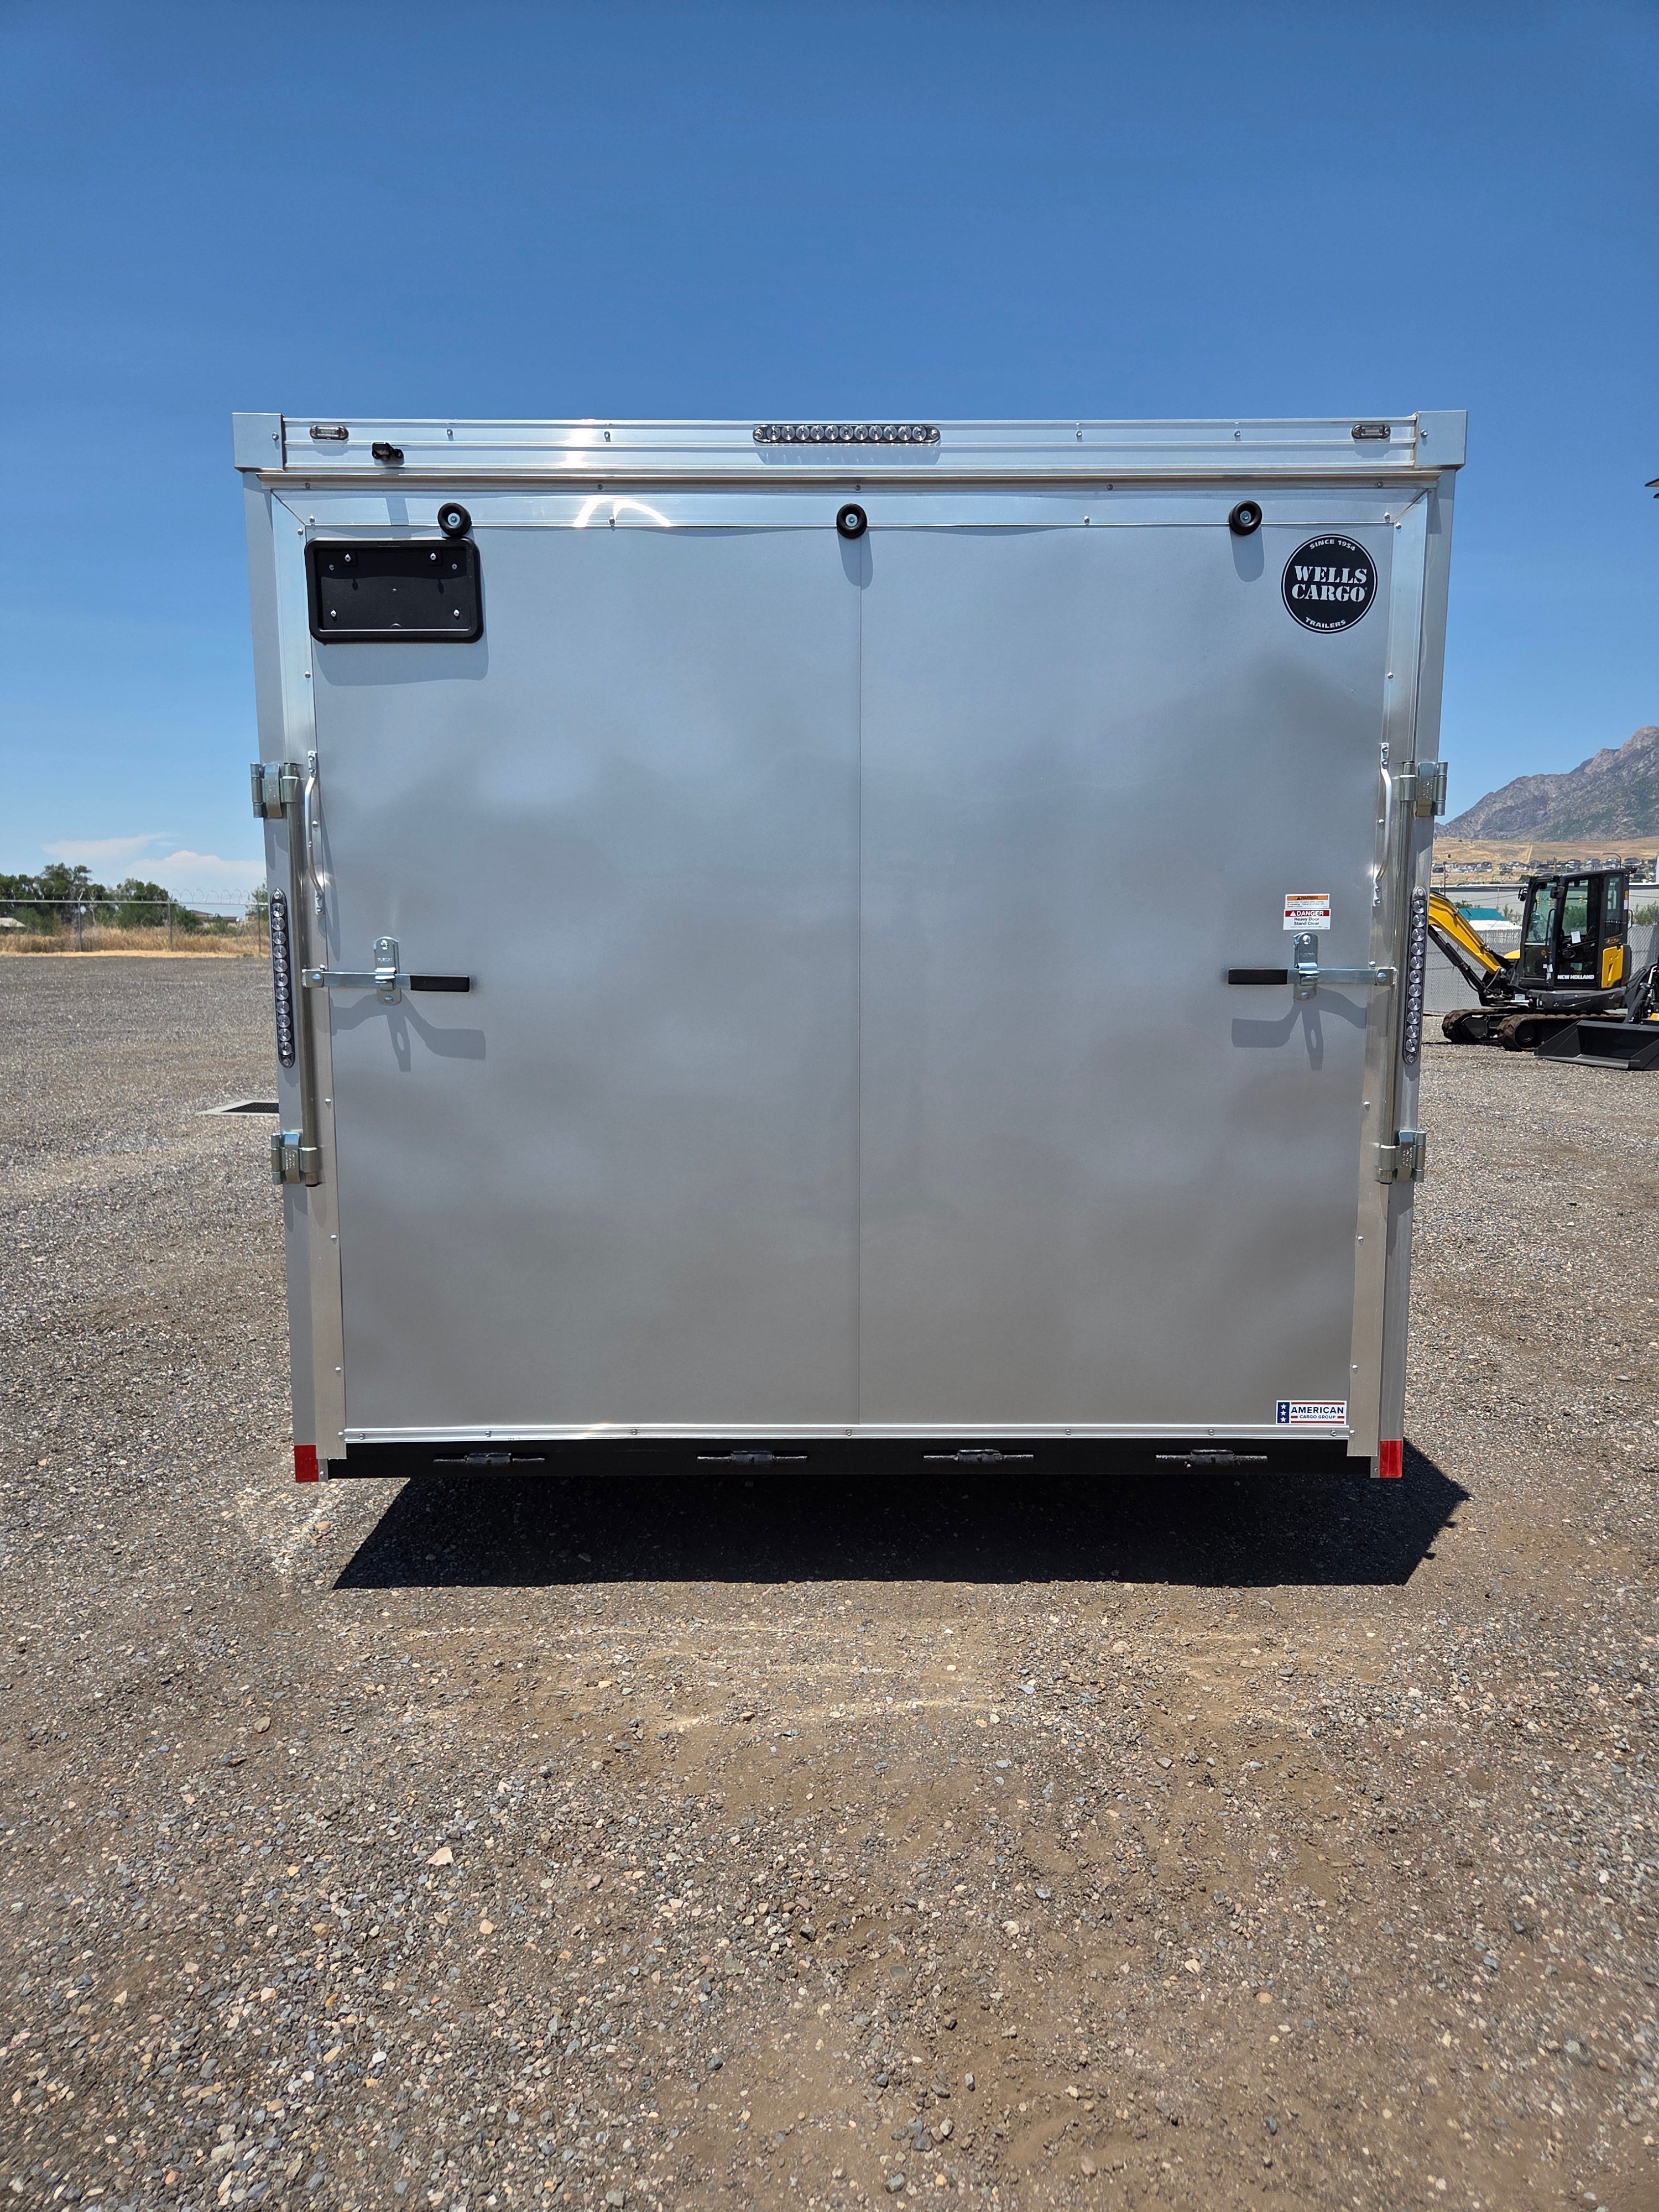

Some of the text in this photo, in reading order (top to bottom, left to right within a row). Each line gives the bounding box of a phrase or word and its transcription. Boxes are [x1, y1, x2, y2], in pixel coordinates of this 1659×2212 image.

[1310, 539, 1356, 551] SINCE 1954
[1294, 565, 1367, 584] WELLS
[1292, 583, 1365, 602] CARGO
[1306, 617, 1346, 628] TRAILERS
